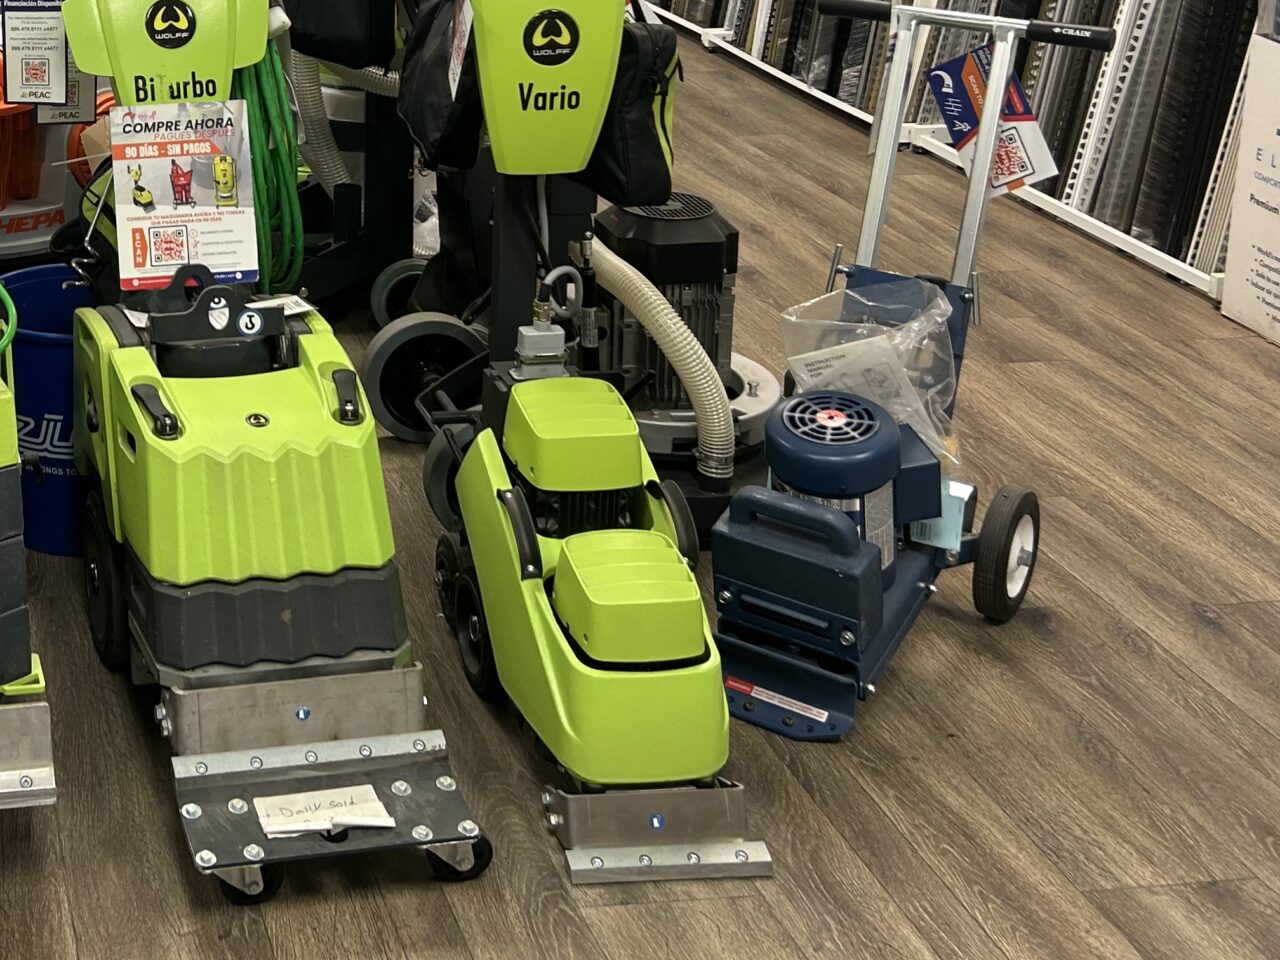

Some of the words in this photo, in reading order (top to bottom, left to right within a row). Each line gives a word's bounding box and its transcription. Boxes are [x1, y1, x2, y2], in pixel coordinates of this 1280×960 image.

[154, 32, 190, 40] WOLFF
[1062, 27, 1092, 38] CRAIN
[532, 48, 572, 56] WOLFF
[134, 71, 217, 103] Biurbo
[29, 91, 51, 99] PEAC
[518, 82, 581, 112] Vario
[58, 111, 80, 119] PEAC
[122, 120, 181, 134] COMPRE
[185, 117, 234, 130] AHORA
[154, 130, 192, 141] PAGUES
[125, 147, 137, 158] 90
[139, 143, 159, 157] DÍAS
[166, 143, 181, 155] SIN
[183, 141, 211, 154] PAGOS
[1249, 193, 1280, 215] Premium
[135, 232, 143, 264] SCAN
[804, 354, 846, 368] INSTRUCTION
[807, 364, 833, 373] MANUAL
[66, 468, 78, 476] TO
[279, 802, 322, 818] Dolly
